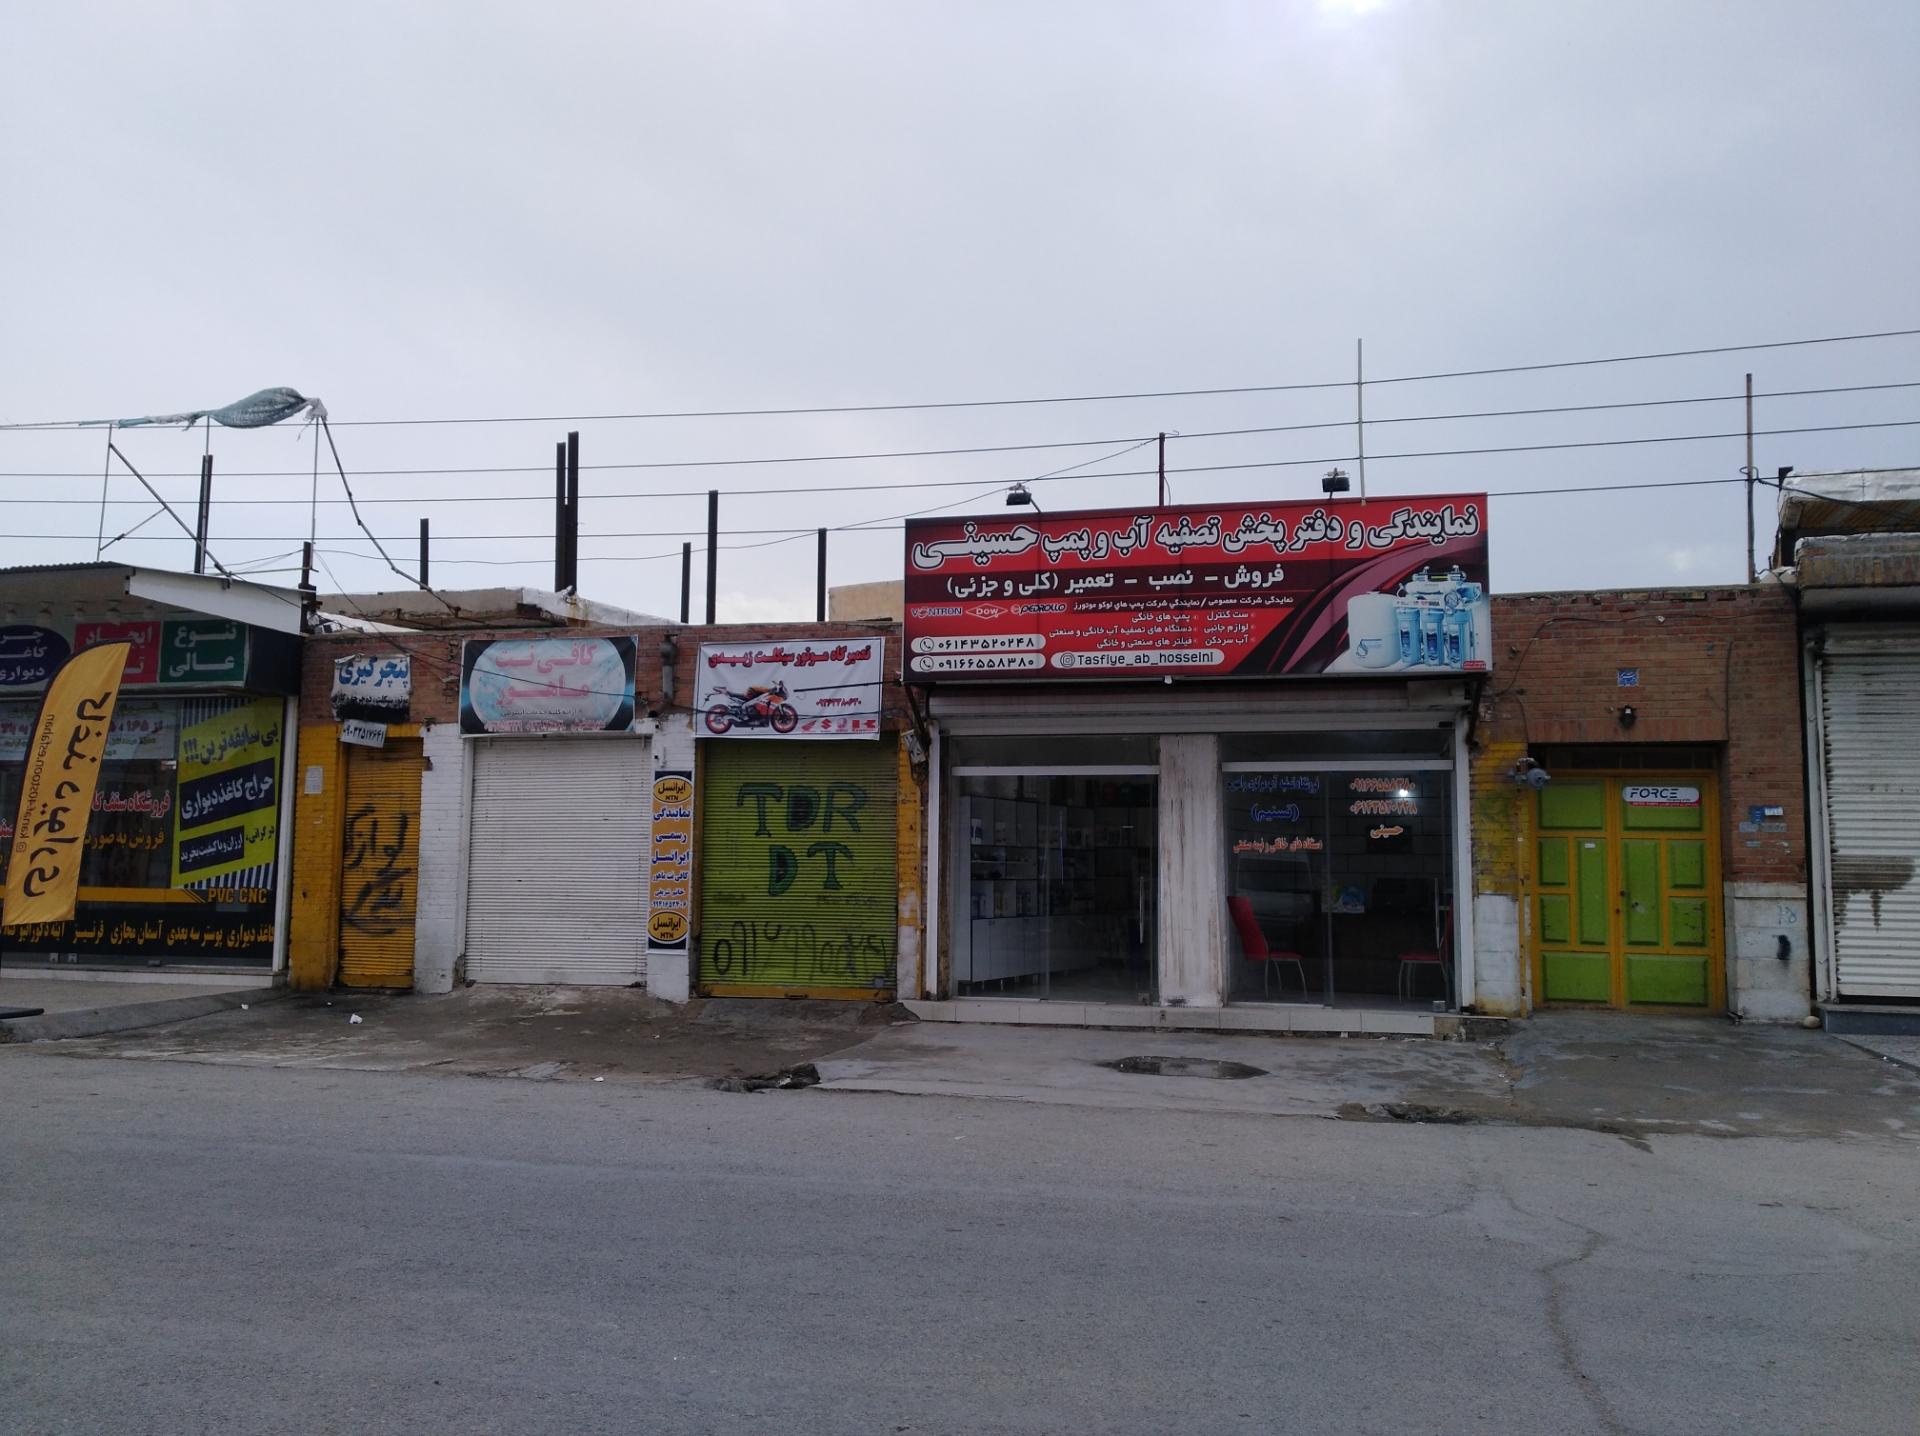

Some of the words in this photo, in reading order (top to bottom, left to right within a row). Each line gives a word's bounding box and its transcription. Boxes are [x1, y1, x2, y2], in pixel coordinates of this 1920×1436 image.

[1112, 514, 1154, 557] آب
[1154, 515, 1221, 554] تصفیه
[1222, 512, 1287, 554] پخش
[1288, 508, 1344, 552] دفتر
[1345, 520, 1364, 550] و
[1367, 503, 1480, 549] نمایندگی
[911, 522, 1041, 570] حسینی
[1041, 527, 1092, 563] پمپ
[1093, 531, 1110, 559] و
[947, 576, 999, 599] جزئی)
[1003, 581, 1013, 596] و
[1018, 571, 1059, 596] (کلی
[1064, 572, 1114, 595] تعمیر
[1148, 569, 1194, 591] نصب
[1224, 564, 1285, 589] فروش
[174, 623, 237, 648] تنوع
[938, 637, 1034, 650] ۰۶۱۴۳۵۲۰۲۴۸
[169, 653, 235, 677] عالی
[496, 645, 536, 668] نت
[537, 641, 598, 674] کافی
[938, 657, 1034, 669] ۰۹۱۶۶۵۵۸۳۸۰
[261, 722, 279, 747] بی
[245, 773, 274, 801] حراج
[657, 780, 686, 796] ایرانسل
[1630, 787, 1679, 799] FORCE
[737, 782, 868, 838] TDR
[1370, 823, 1404, 839] حسینی
[767, 841, 856, 897] DT
[207, 888, 235, 904] PVC
[239, 887, 268, 904] CNC
[653, 917, 682, 931] ایرانسل
[660, 932, 674, 940] MTN
